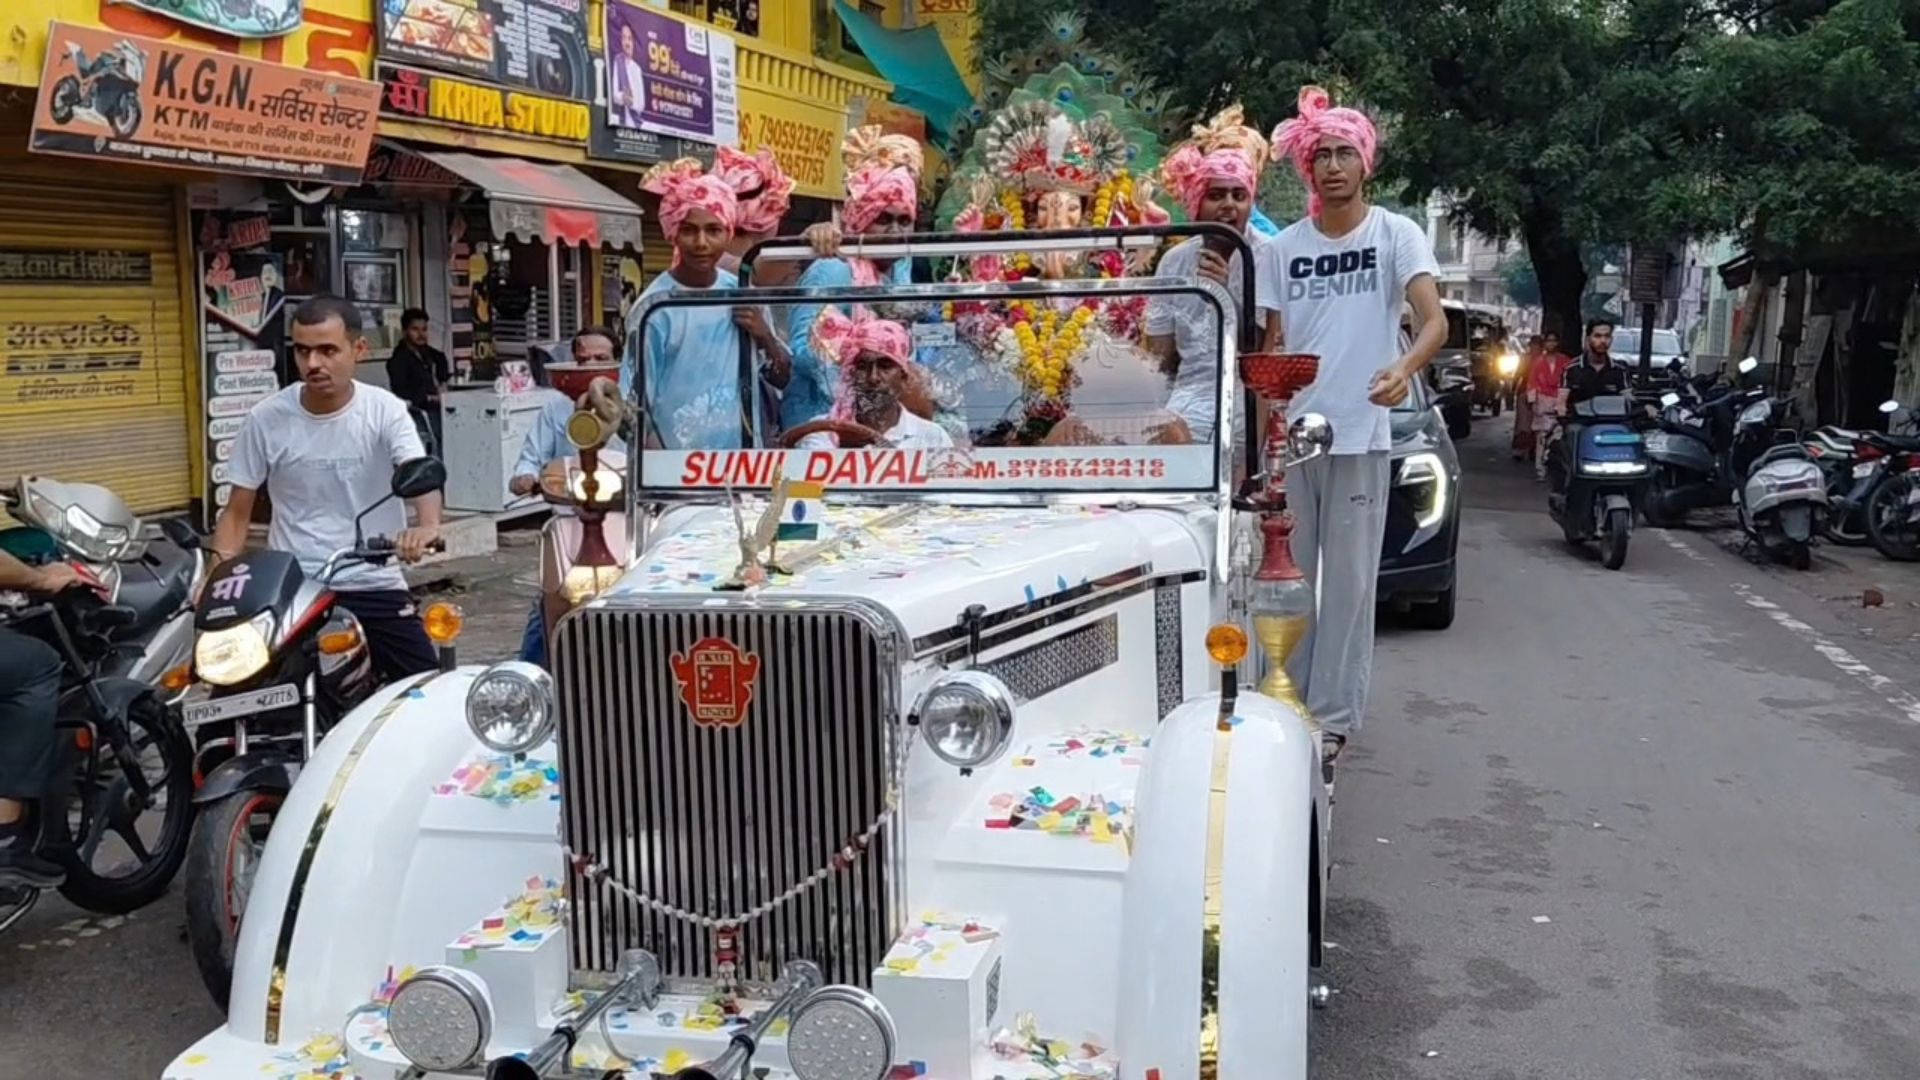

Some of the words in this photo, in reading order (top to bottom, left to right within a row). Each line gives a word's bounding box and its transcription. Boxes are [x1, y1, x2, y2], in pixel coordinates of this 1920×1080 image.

[153, 50, 255, 112] K.G.N.
[153, 104, 209, 131] KTM
[260, 88, 318, 122] सर्विस
[430, 78, 504, 128] KRIPA
[506, 92, 590, 140] STUDIO
[1289, 246, 1376, 279] CODE
[1288, 269, 1378, 302] DENIM
[804, 450, 928, 484] DAYAL
